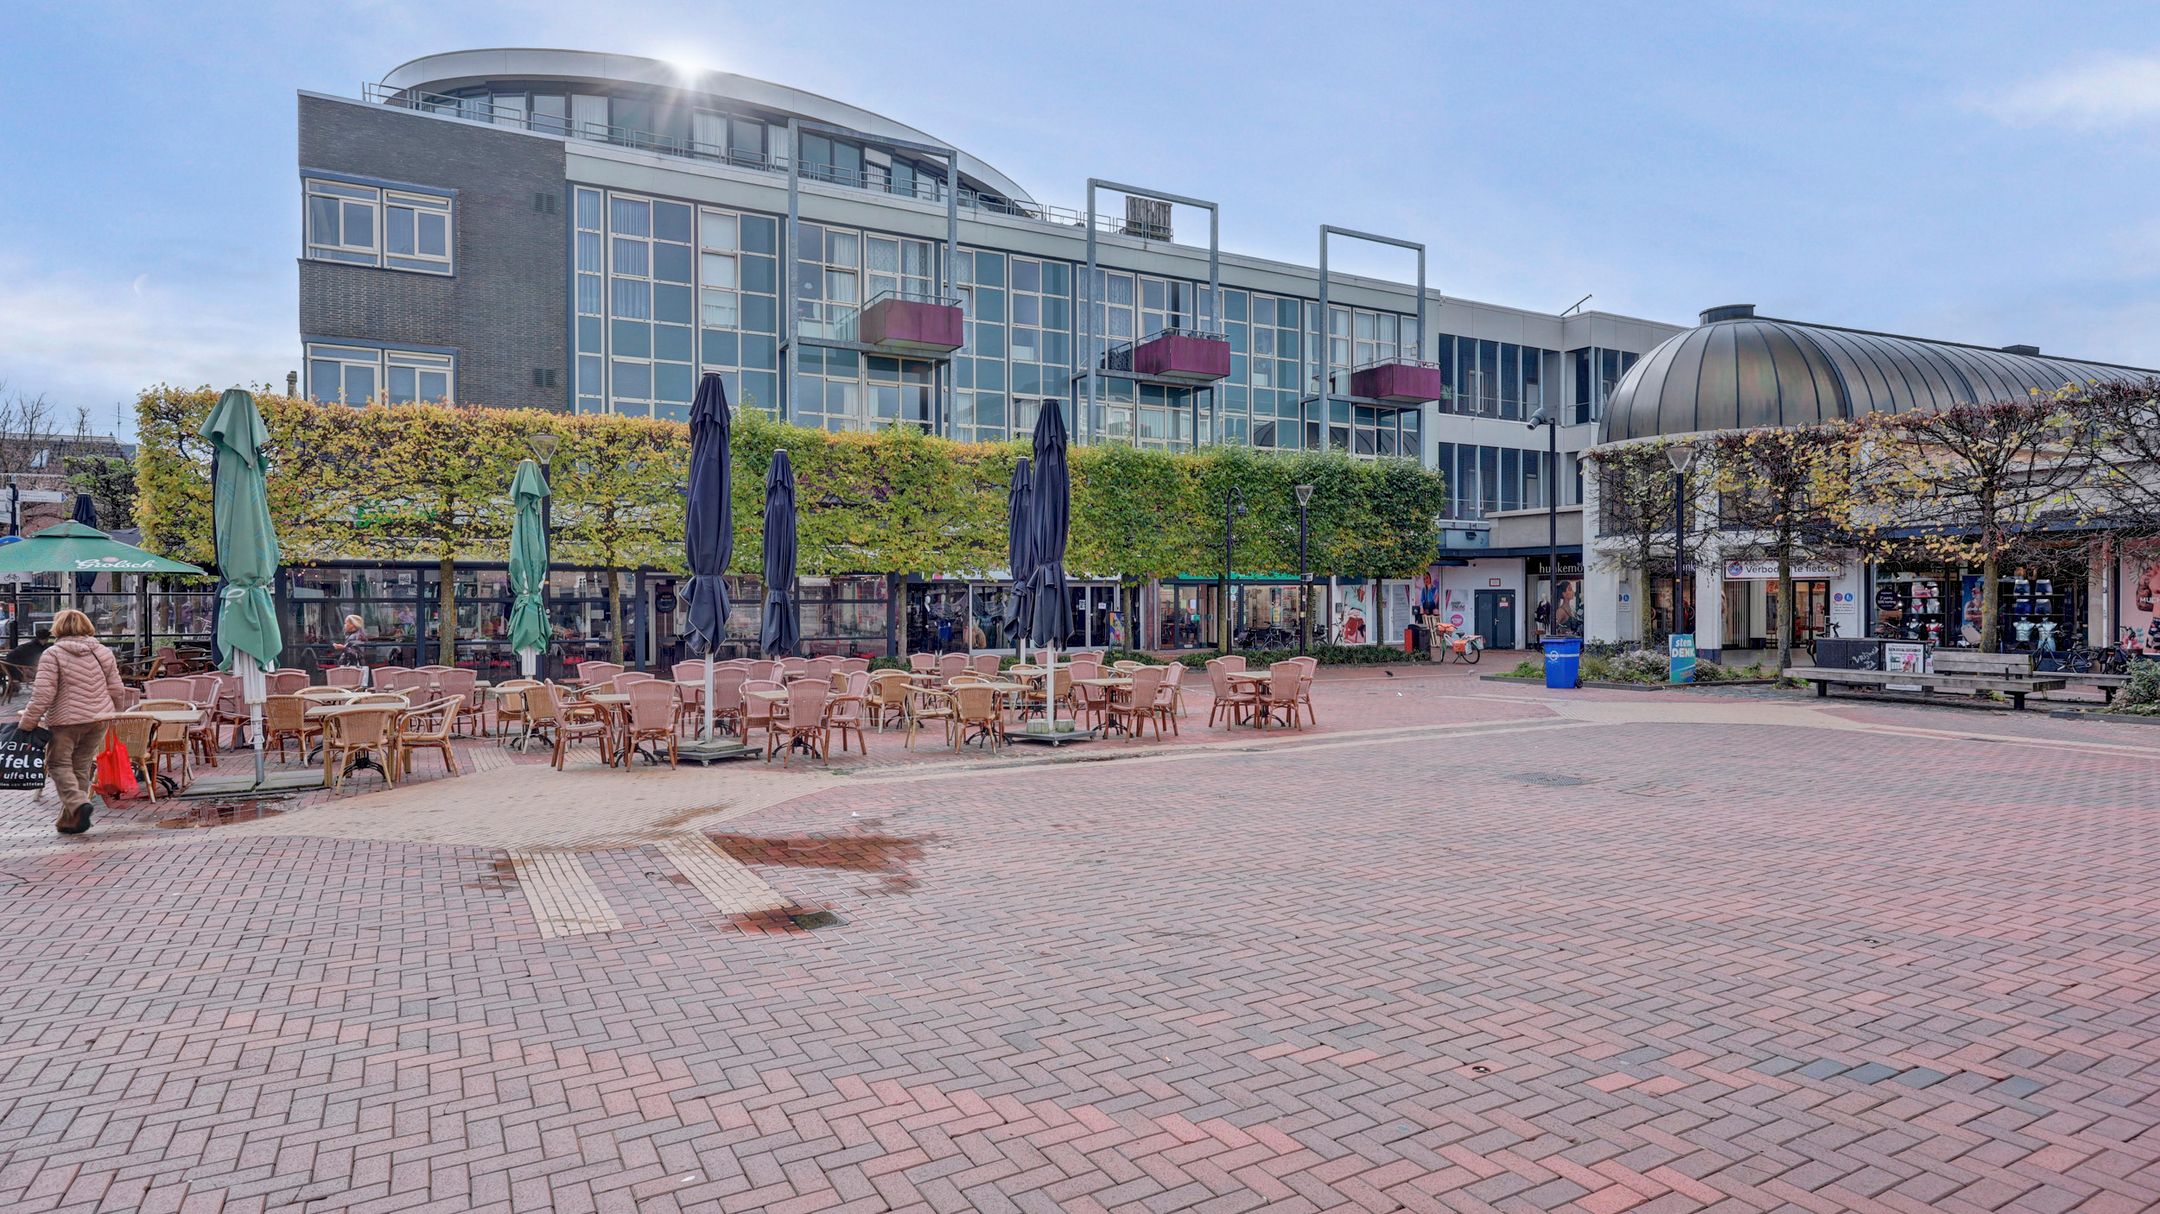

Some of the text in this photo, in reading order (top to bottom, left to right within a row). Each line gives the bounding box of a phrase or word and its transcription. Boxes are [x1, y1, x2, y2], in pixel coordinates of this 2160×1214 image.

[75, 558, 156, 569] Grolsch
[1746, 562, 1780, 574] Verbod
[1794, 562, 1804, 573] te
